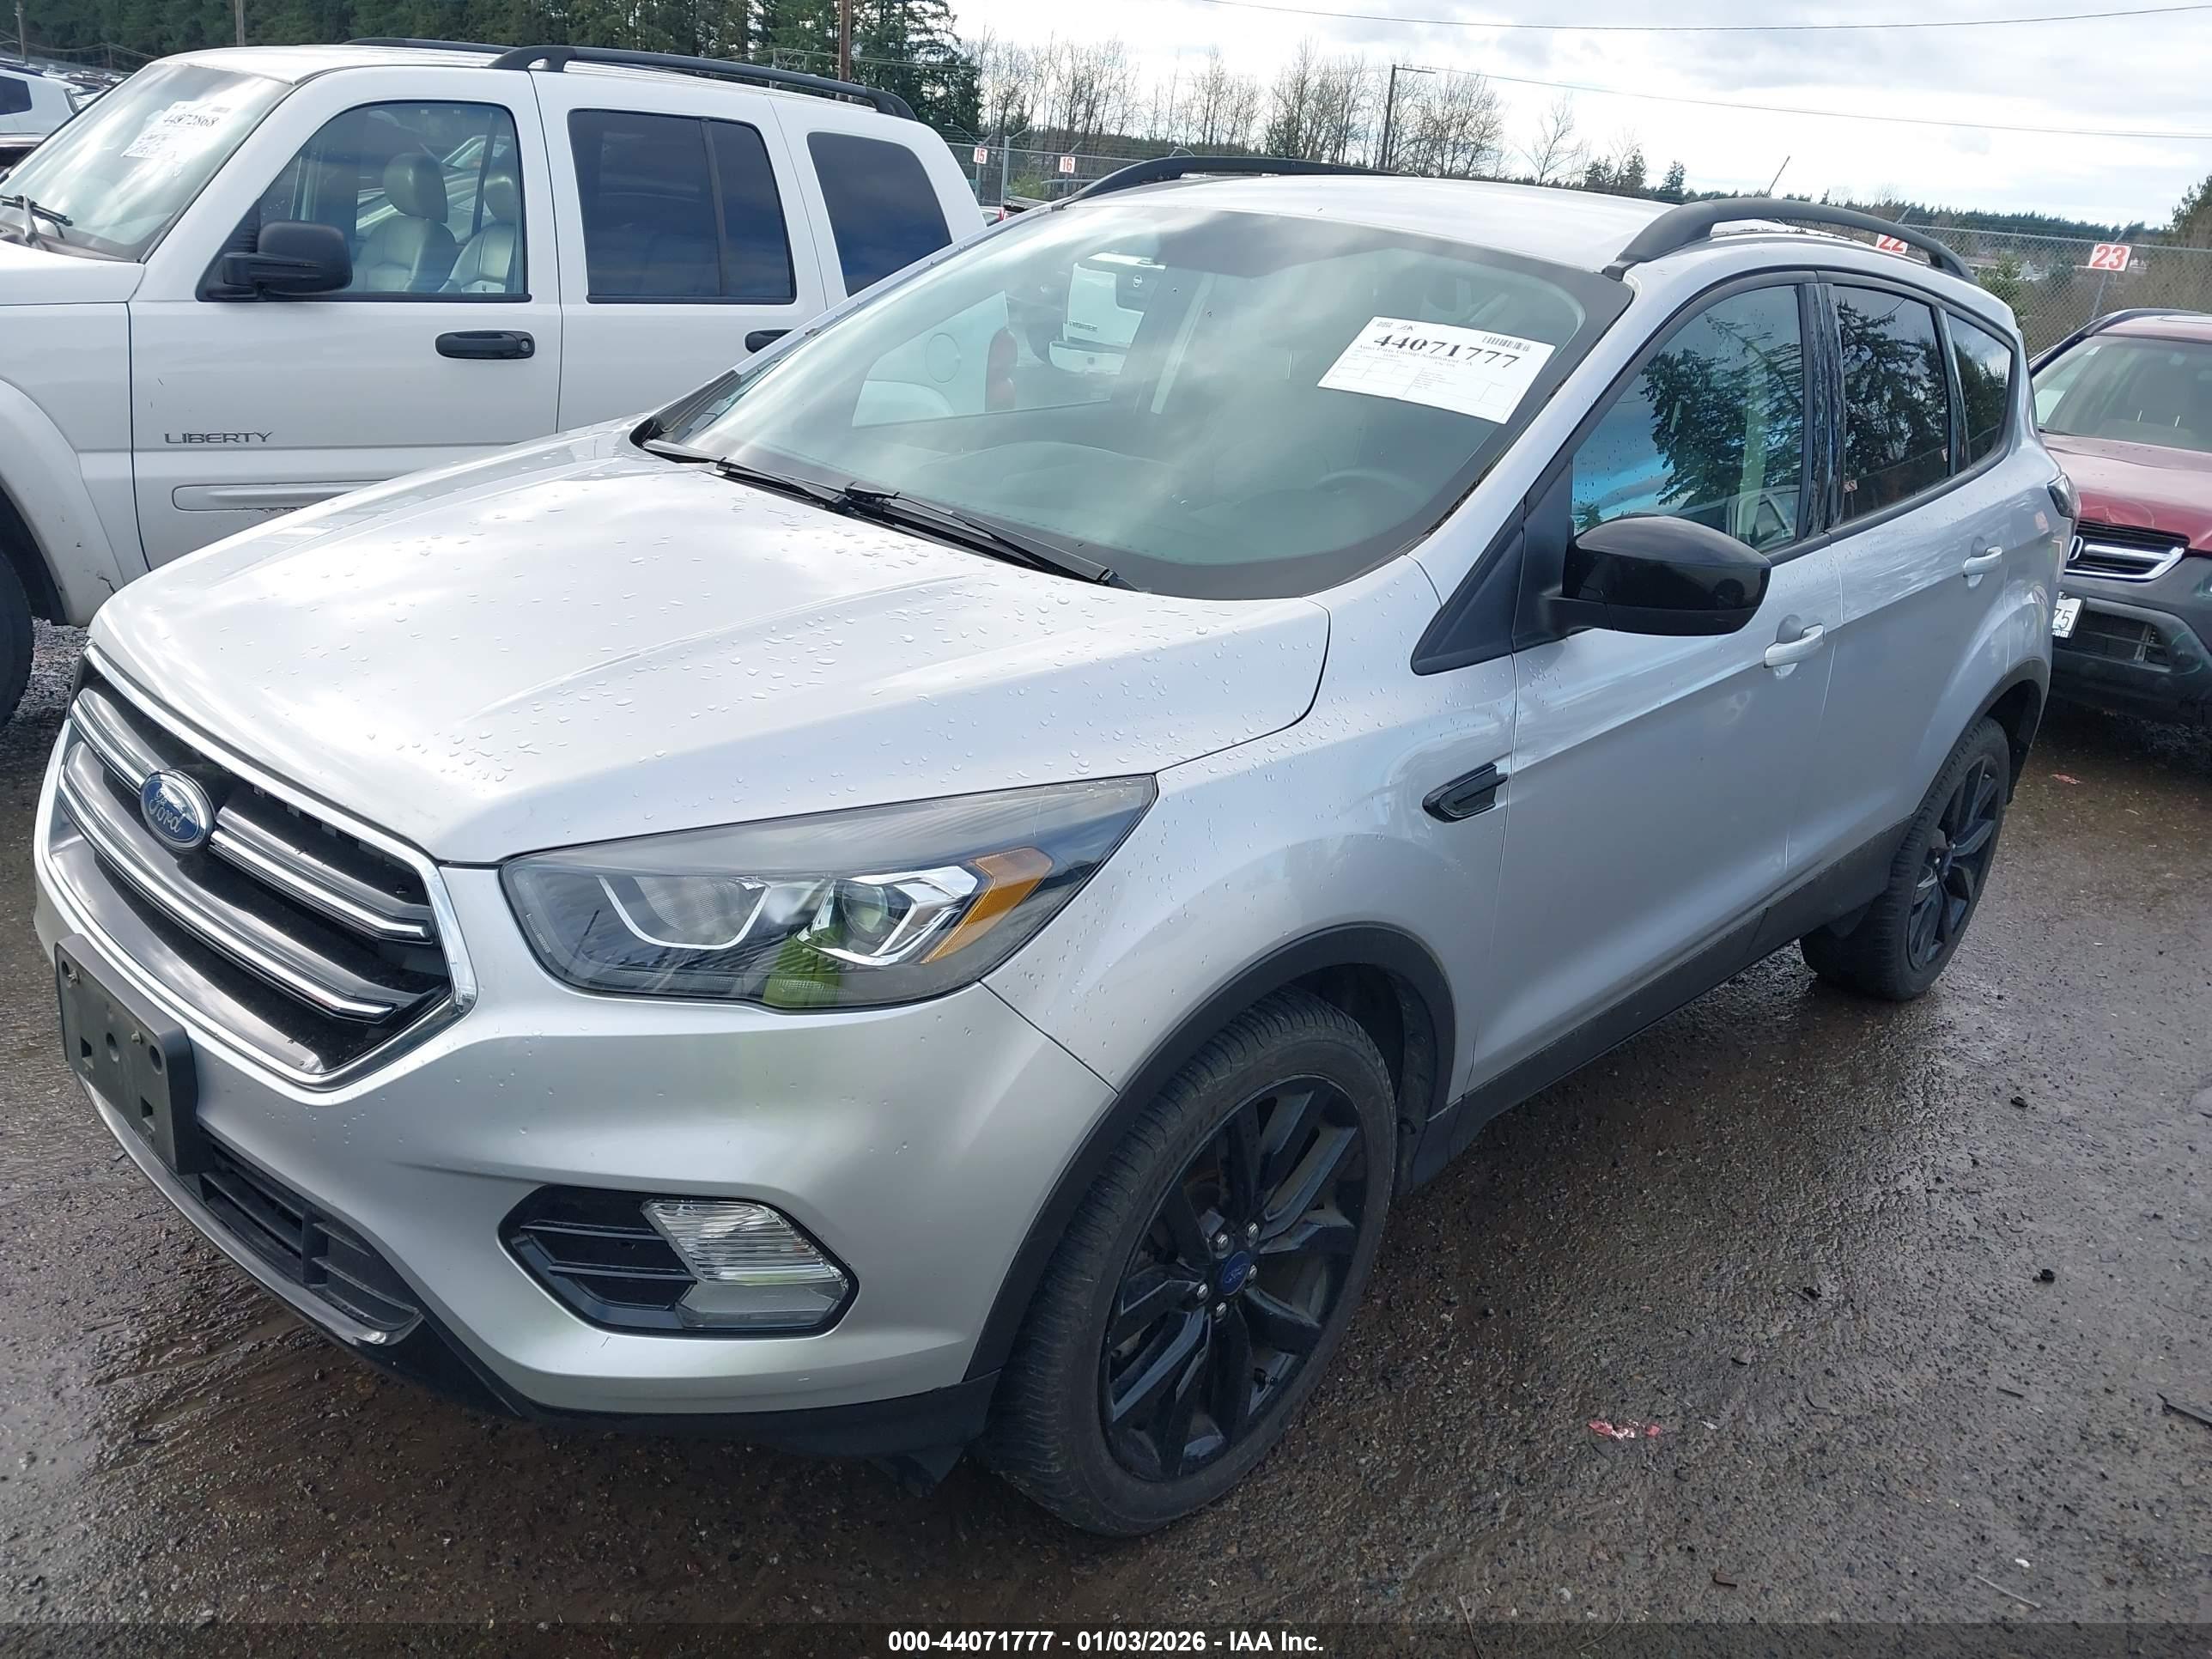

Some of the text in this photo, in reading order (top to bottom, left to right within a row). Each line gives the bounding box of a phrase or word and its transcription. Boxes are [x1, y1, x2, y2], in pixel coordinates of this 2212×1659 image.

[975, 149, 985, 162] 15
[1063, 157, 1073, 171] 16
[2092, 245, 2127, 270] 23
[1374, 334, 1521, 368] 44071777
[164, 431, 273, 444] LIBERTY
[149, 788, 186, 834] Ford
